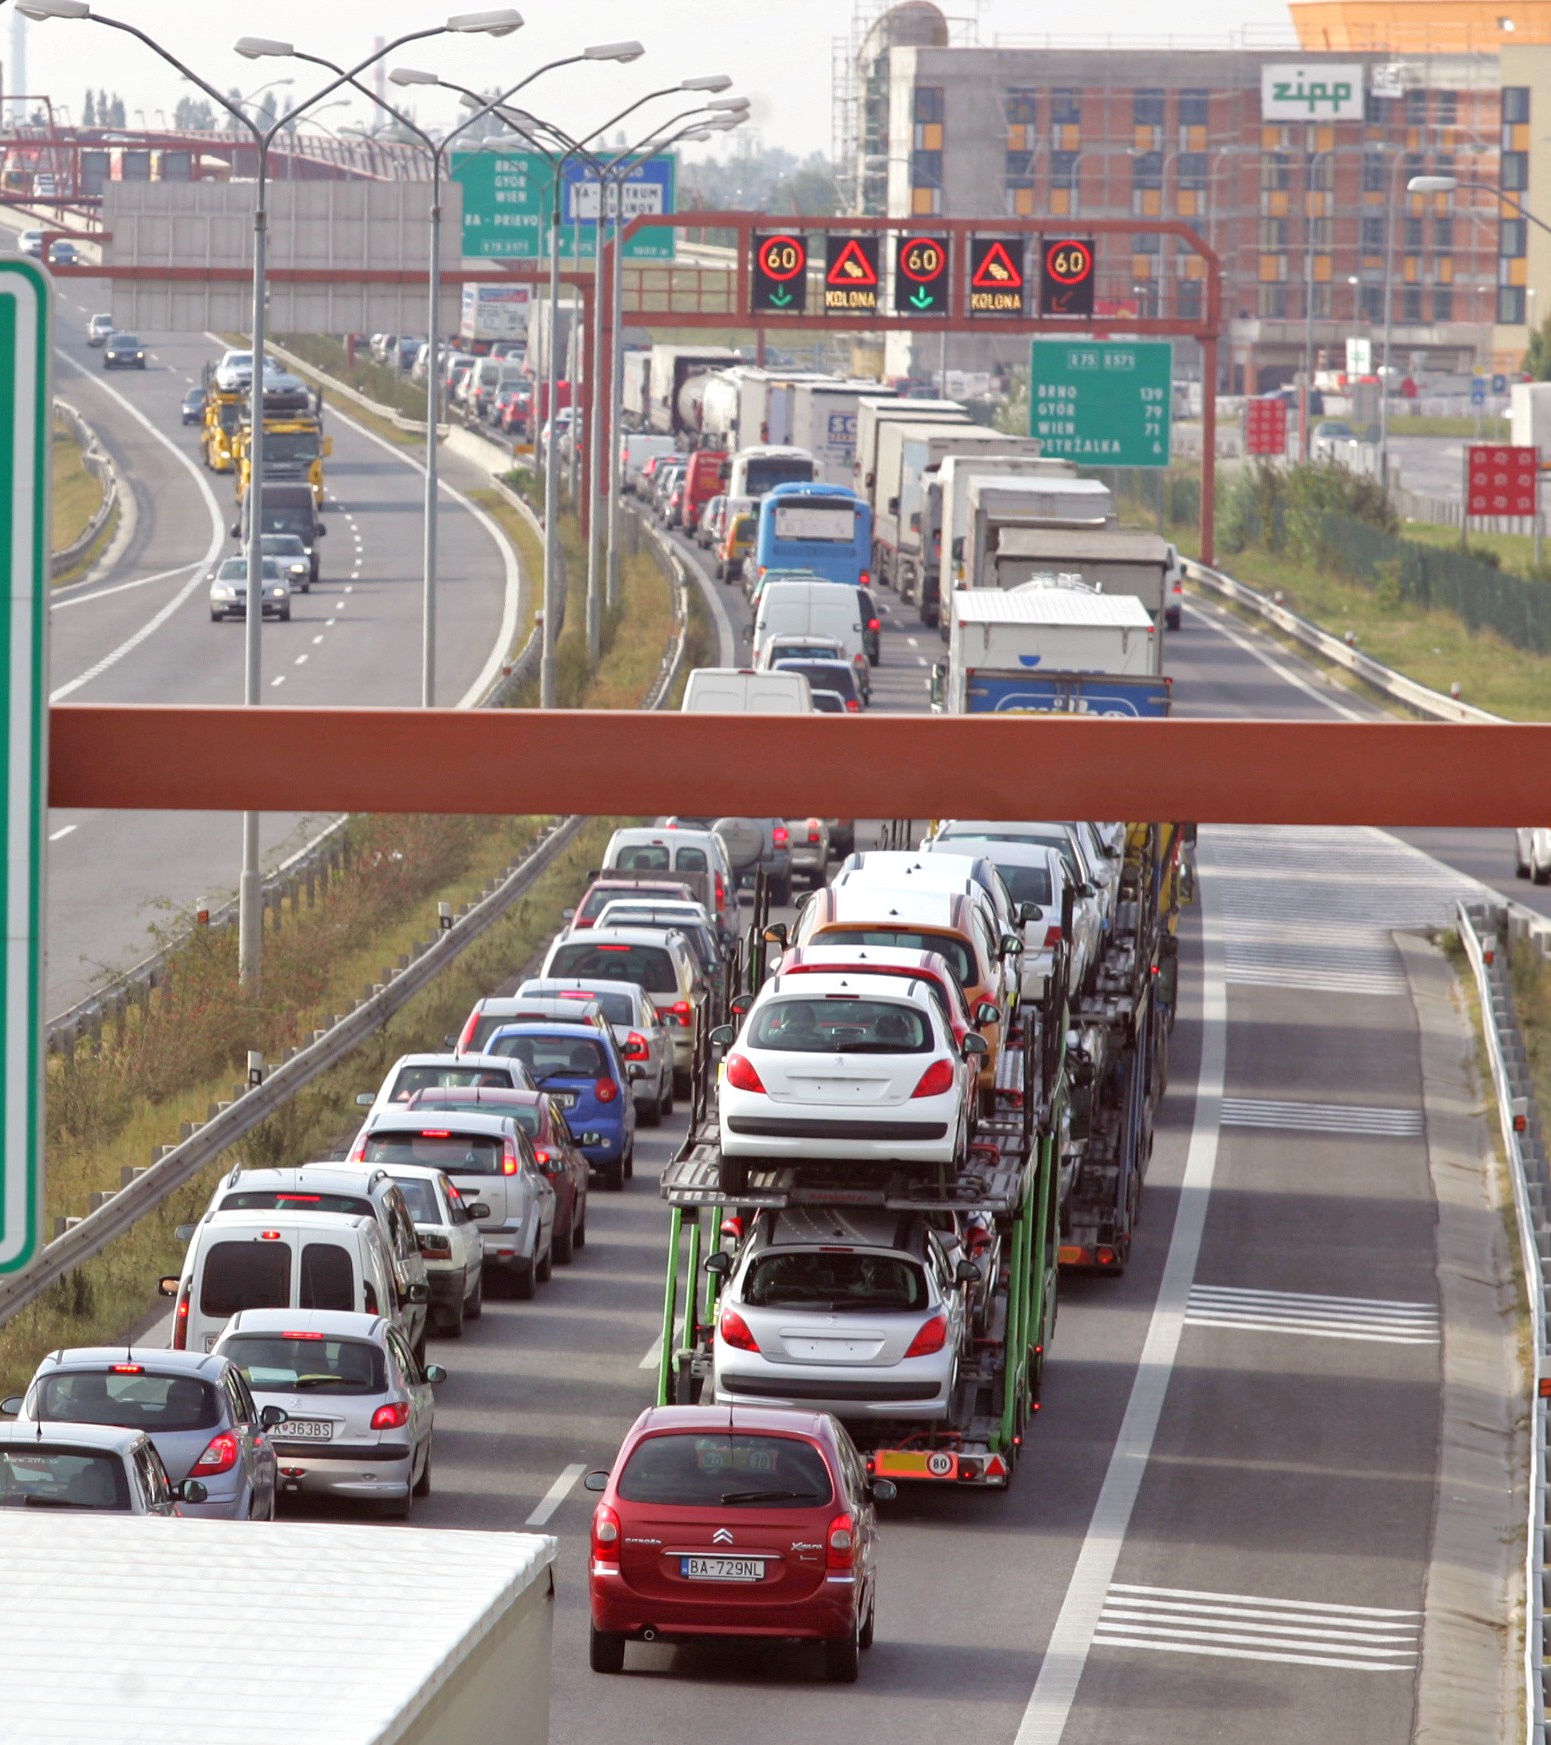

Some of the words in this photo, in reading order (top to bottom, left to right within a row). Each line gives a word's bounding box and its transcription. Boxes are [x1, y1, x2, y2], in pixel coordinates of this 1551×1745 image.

[1272, 70, 1352, 113] zipp
[494, 214, 544, 227] PRIEVO
[767, 247, 796, 269] 60
[908, 249, 937, 271] 60
[1054, 251, 1084, 273] 60
[825, 290, 876, 308] KOLONA
[970, 293, 1022, 310] KOLONA
[1038, 385, 1077, 399] BRNO
[1140, 387, 1163, 401] 139
[1144, 405, 1162, 419] 79
[1037, 421, 1075, 434] WIEN
[1144, 423, 1160, 436] 71
[1152, 441, 1162, 454] 6
[933, 1458, 947, 1469] 80
[689, 1559, 762, 1577] BA-729NL
